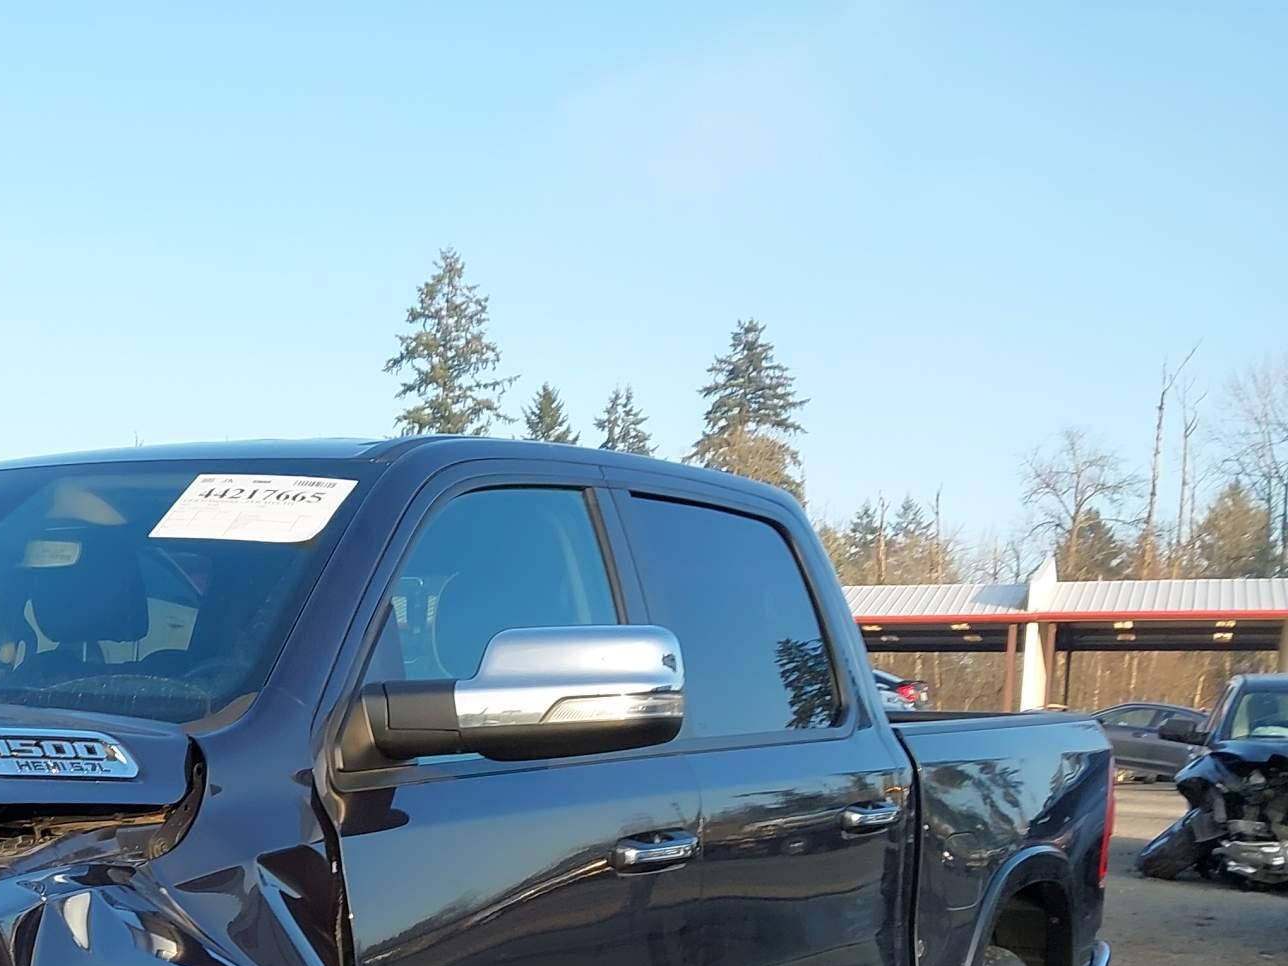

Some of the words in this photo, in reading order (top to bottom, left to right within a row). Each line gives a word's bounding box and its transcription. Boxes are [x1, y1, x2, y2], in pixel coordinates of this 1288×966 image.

[198, 487, 327, 504] 44217665
[16, 760, 67, 772] HEMI
[72, 762, 112, 773] 5.7L
